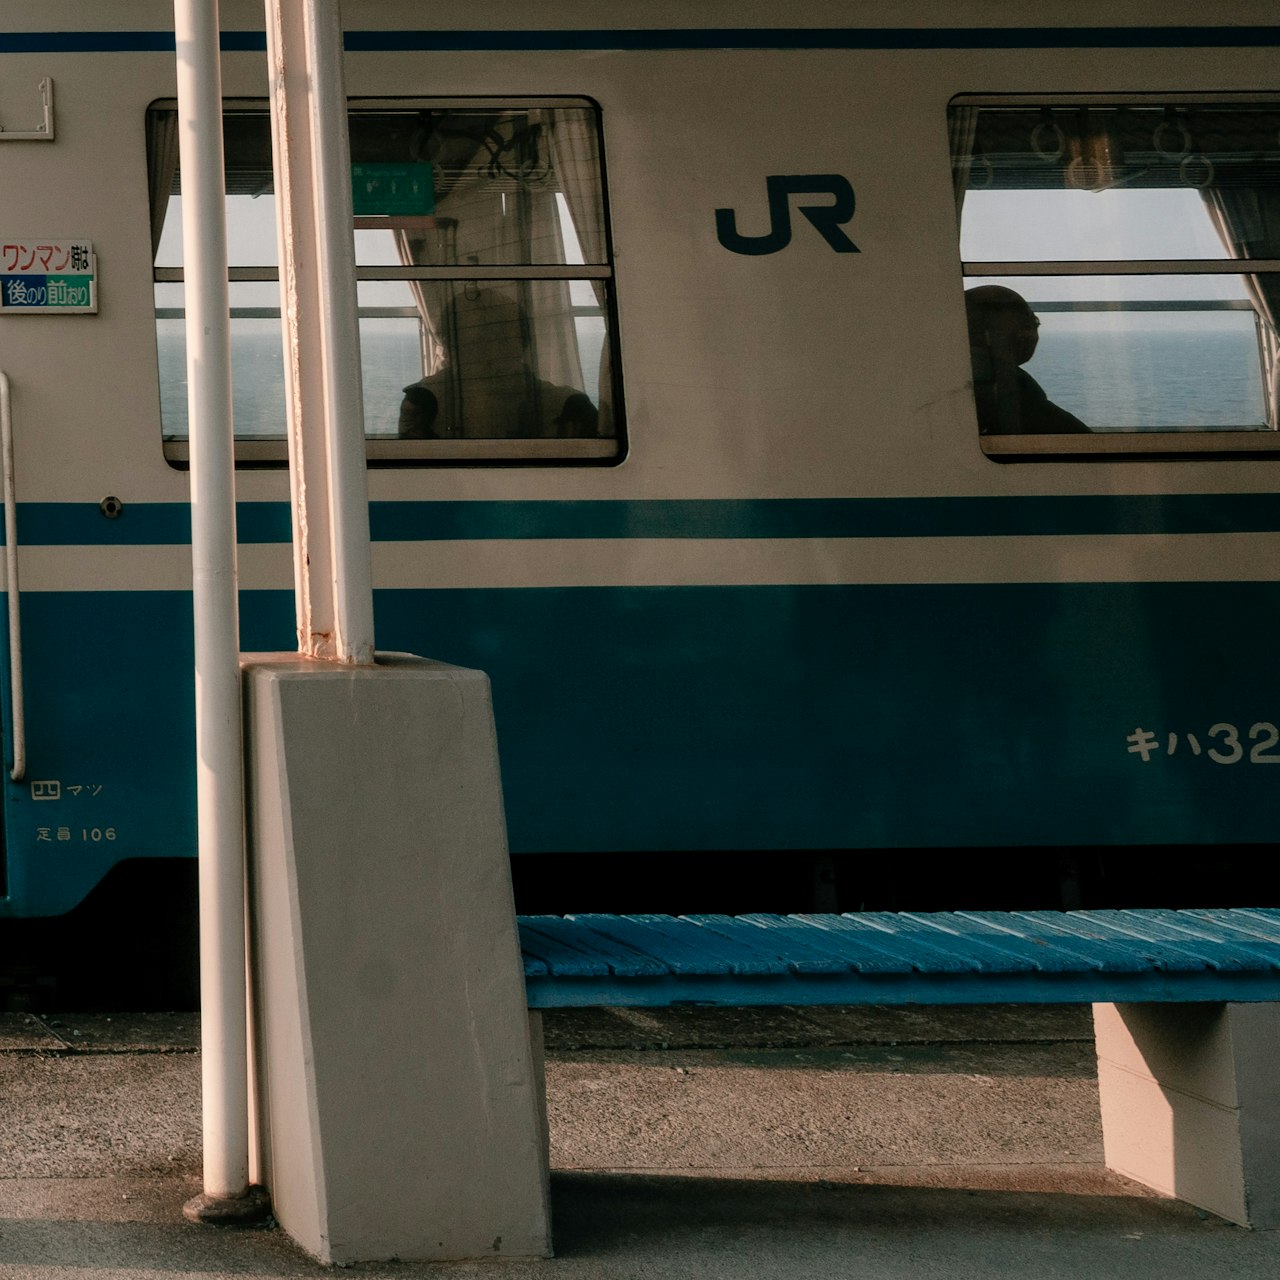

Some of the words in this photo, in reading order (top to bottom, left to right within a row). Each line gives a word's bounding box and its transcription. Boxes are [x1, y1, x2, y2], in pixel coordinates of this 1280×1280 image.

[715, 174, 861, 255] JR
[2, 244, 89, 271] ワンマン時は
[1126, 722, 1280, 764] キハ32
[36, 827, 70, 841] 定員
[82, 827, 116, 841] 106
